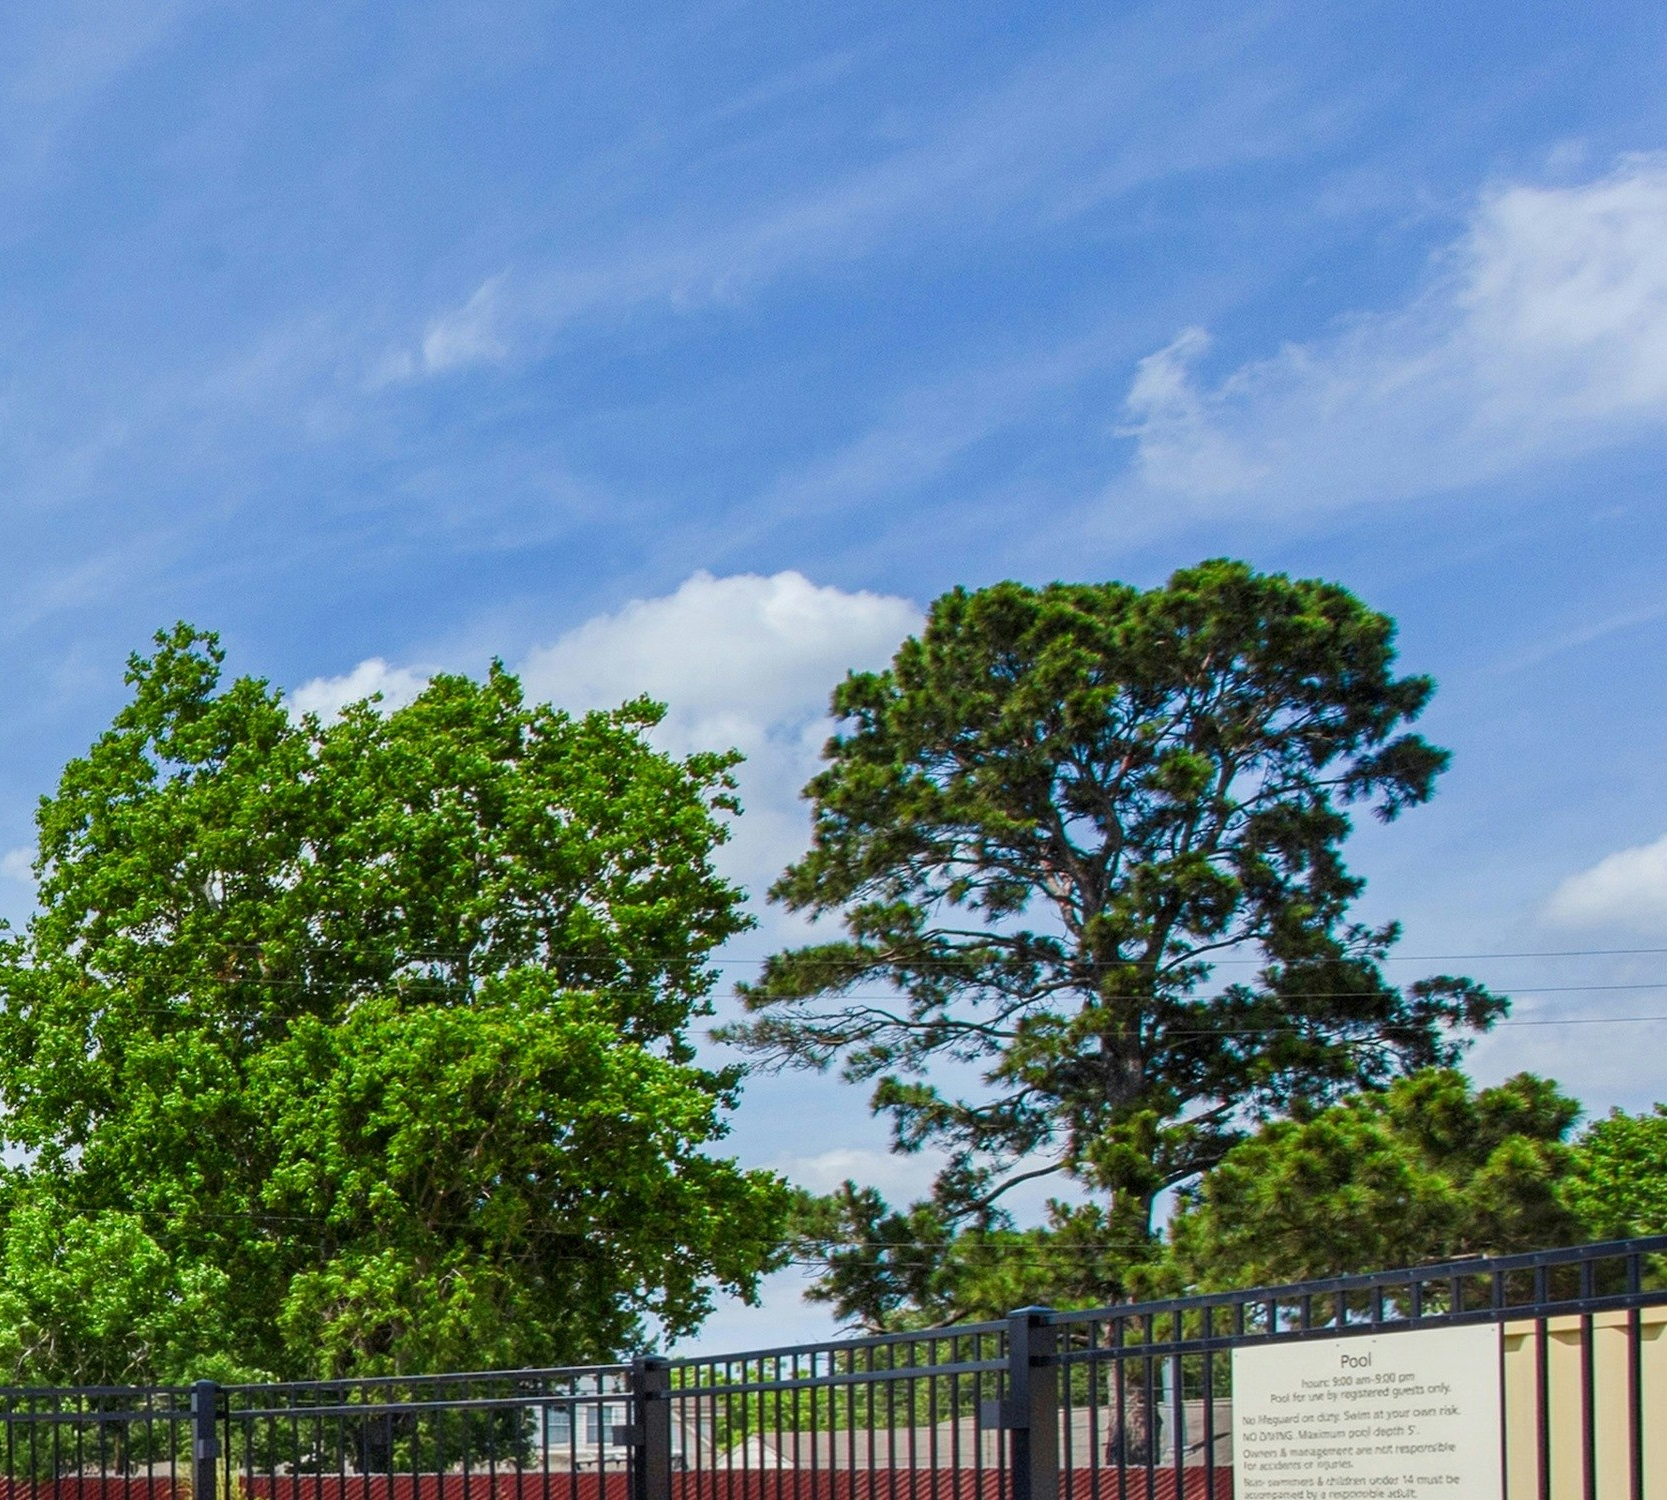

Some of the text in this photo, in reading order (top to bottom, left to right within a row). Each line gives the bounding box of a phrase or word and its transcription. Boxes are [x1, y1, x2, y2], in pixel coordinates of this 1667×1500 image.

[1340, 1351, 1372, 1369] Pool
[1397, 1372, 1415, 1383] pm
[1269, 1393, 1290, 1405] Pool
[1325, 1389, 1338, 1402] by
[1340, 1386, 1389, 1401] registered
[1391, 1383, 1424, 1398] guests
[1242, 1415, 1255, 1426] No
[1301, 1414, 1314, 1422] on
[1343, 1408, 1370, 1420] Swim
[1372, 1408, 1383, 1418] at
[1385, 1408, 1410, 1419] your
[1412, 1406, 1436, 1416] own
[1438, 1403, 1461, 1415] risk.
[1242, 1432, 1257, 1442] NO
[1297, 1427, 1345, 1439] Maximum
[1347, 1426, 1370, 1438] pool
[1372, 1424, 1404, 1437] depth
[1355, 1446, 1372, 1454] are
[1374, 1443, 1393, 1453] not
[1303, 1461, 1314, 1469] or
[1445, 1473, 1460, 1484] be
[1305, 1489, 1317, 1500] by
